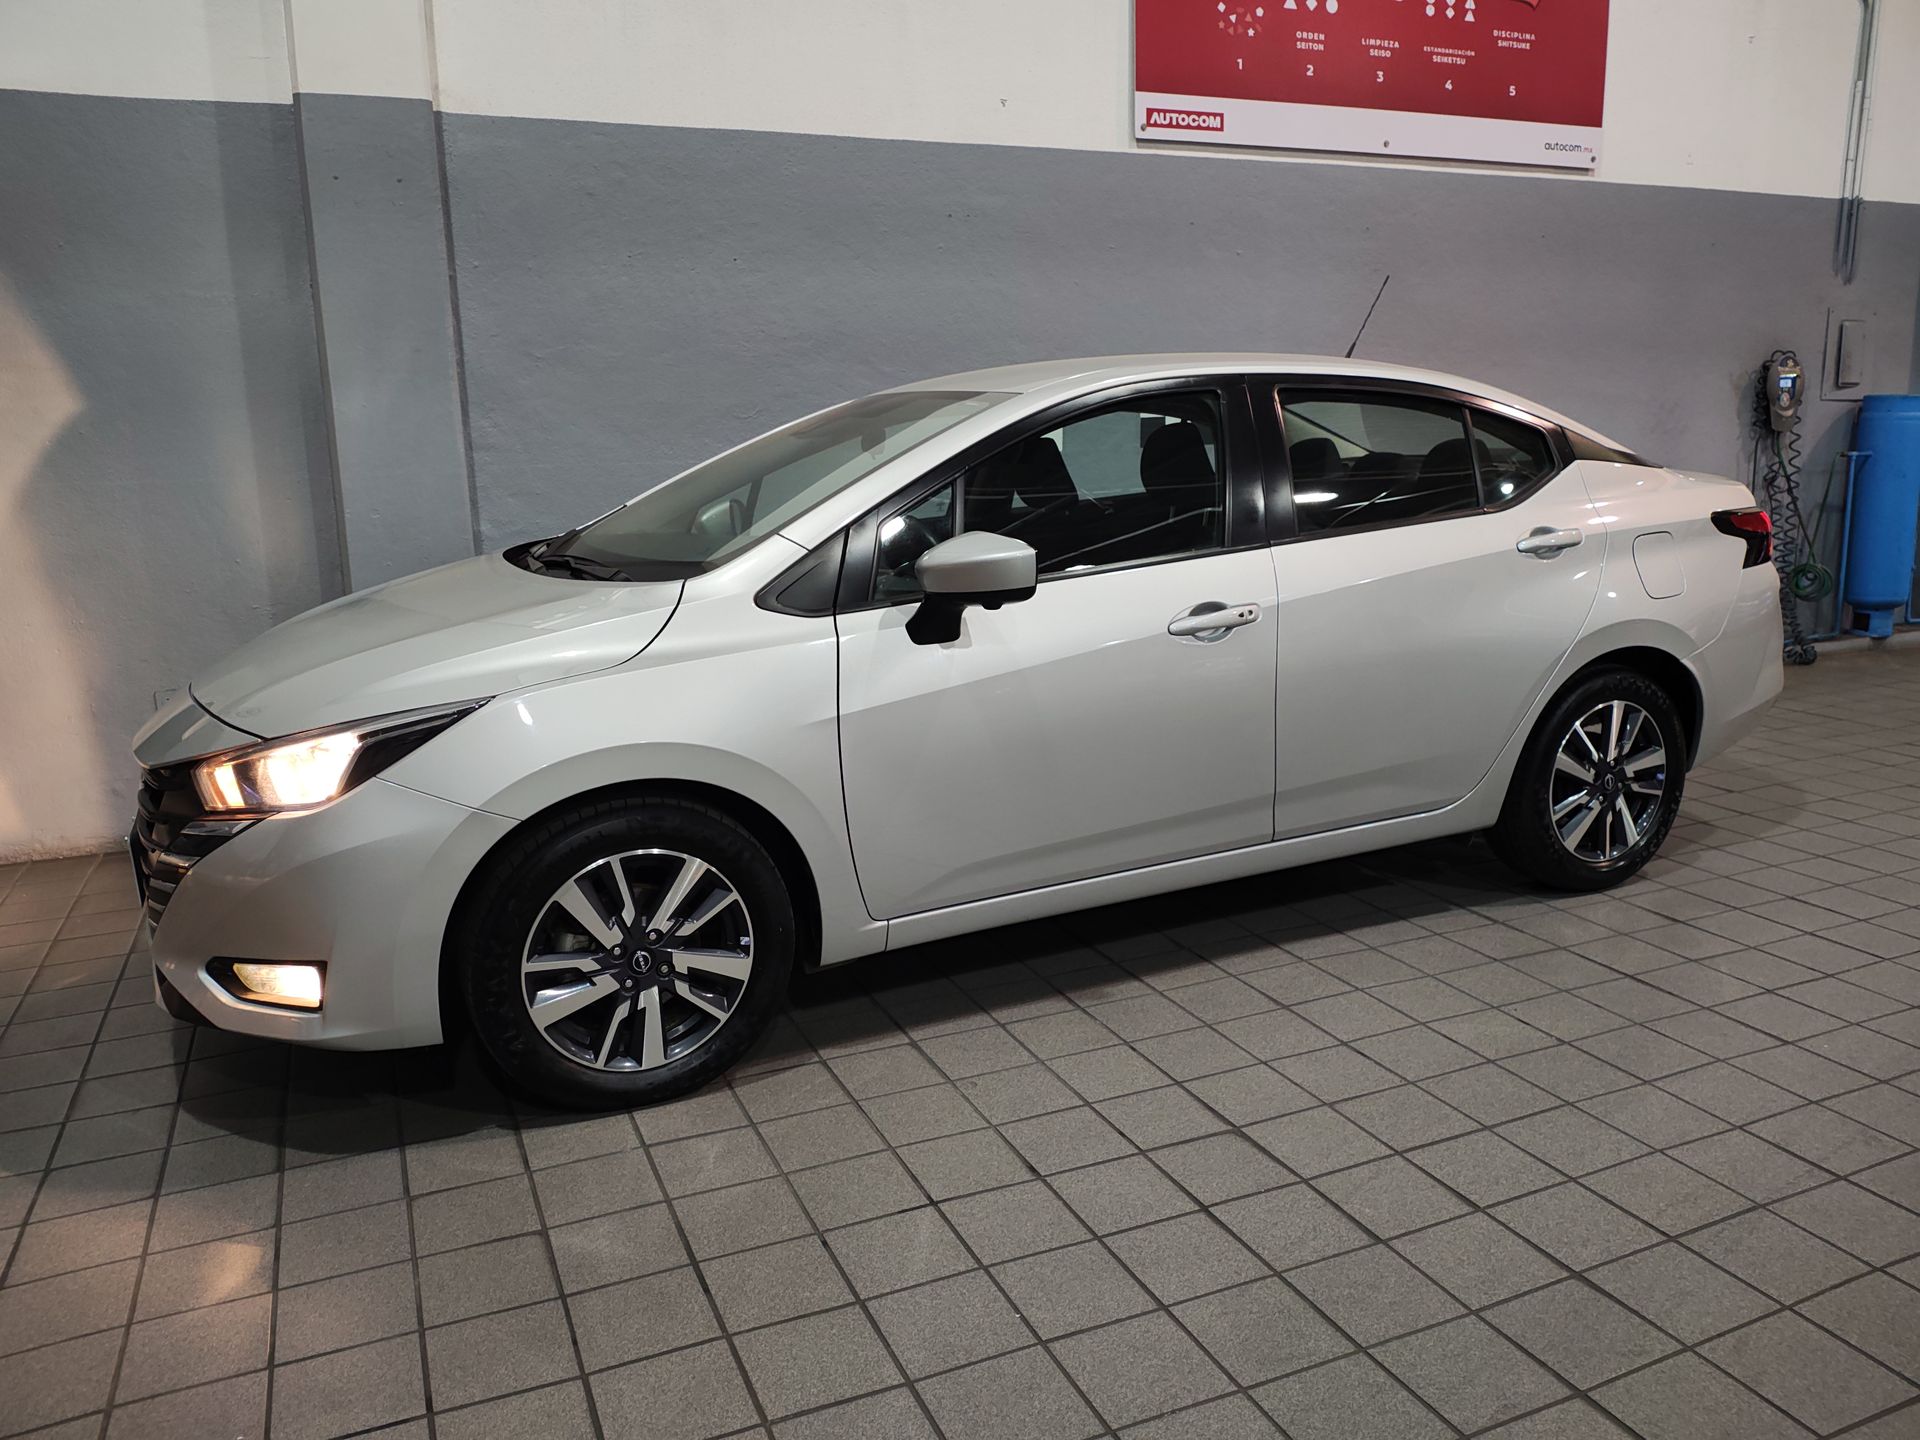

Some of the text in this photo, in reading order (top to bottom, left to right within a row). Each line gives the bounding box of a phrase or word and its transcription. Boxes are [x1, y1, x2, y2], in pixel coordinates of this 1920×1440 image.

[1296, 31, 1325, 40] ORDEN
[1493, 30, 1535, 40] DISCIPLINA
[1296, 41, 1325, 51] SEITON
[1361, 38, 1400, 48] LIMPIEZA
[1497, 40, 1531, 50] SHITSUKE
[1369, 48, 1392, 58] SEISO
[1236, 58, 1243, 70] 1
[1432, 55, 1466, 65] SEIKETSU
[1306, 64, 1314, 76] 2
[1376, 71, 1384, 82] 3
[1445, 80, 1453, 90] 4
[1509, 86, 1516, 96] 5
[1150, 112, 1221, 129] AUTOCOM
